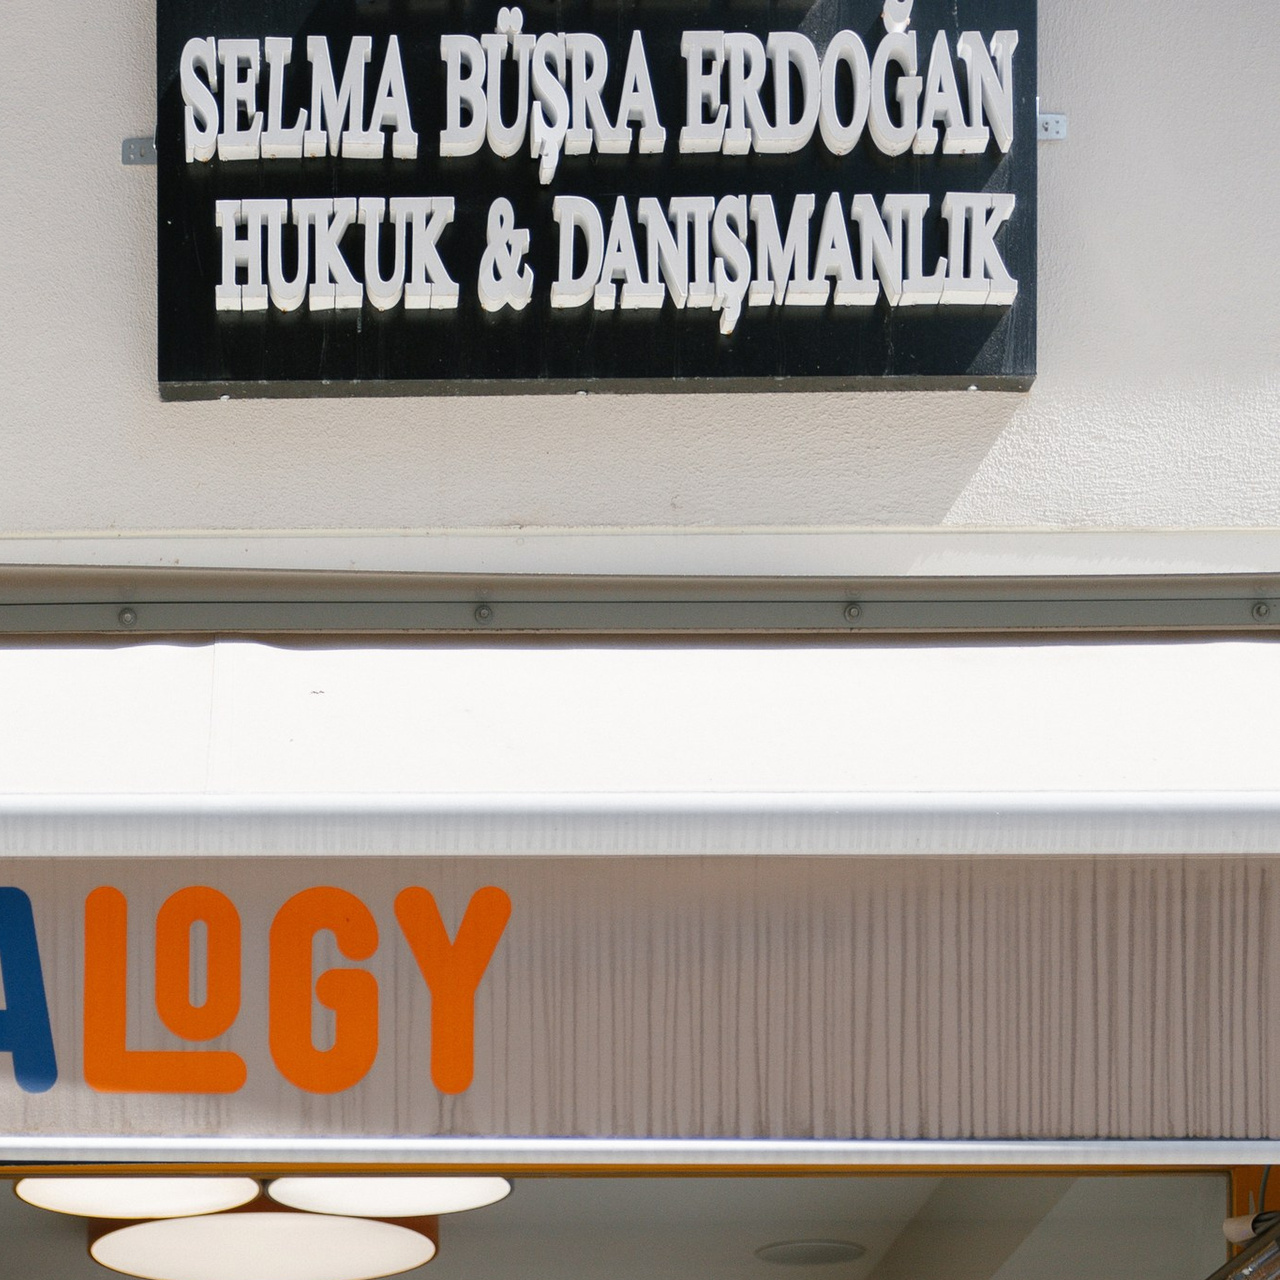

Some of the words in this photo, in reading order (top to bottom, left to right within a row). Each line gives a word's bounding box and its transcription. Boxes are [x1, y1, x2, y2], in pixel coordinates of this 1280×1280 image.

[181, 34, 419, 163] SELMA
[440, 7, 666, 186] BÜŞRA
[680, 0, 1018, 158] ERDOĞAN
[214, 196, 460, 312] HUKUK
[478, 197, 534, 312] &
[550, 192, 1017, 335] DANIŞMANLIK
